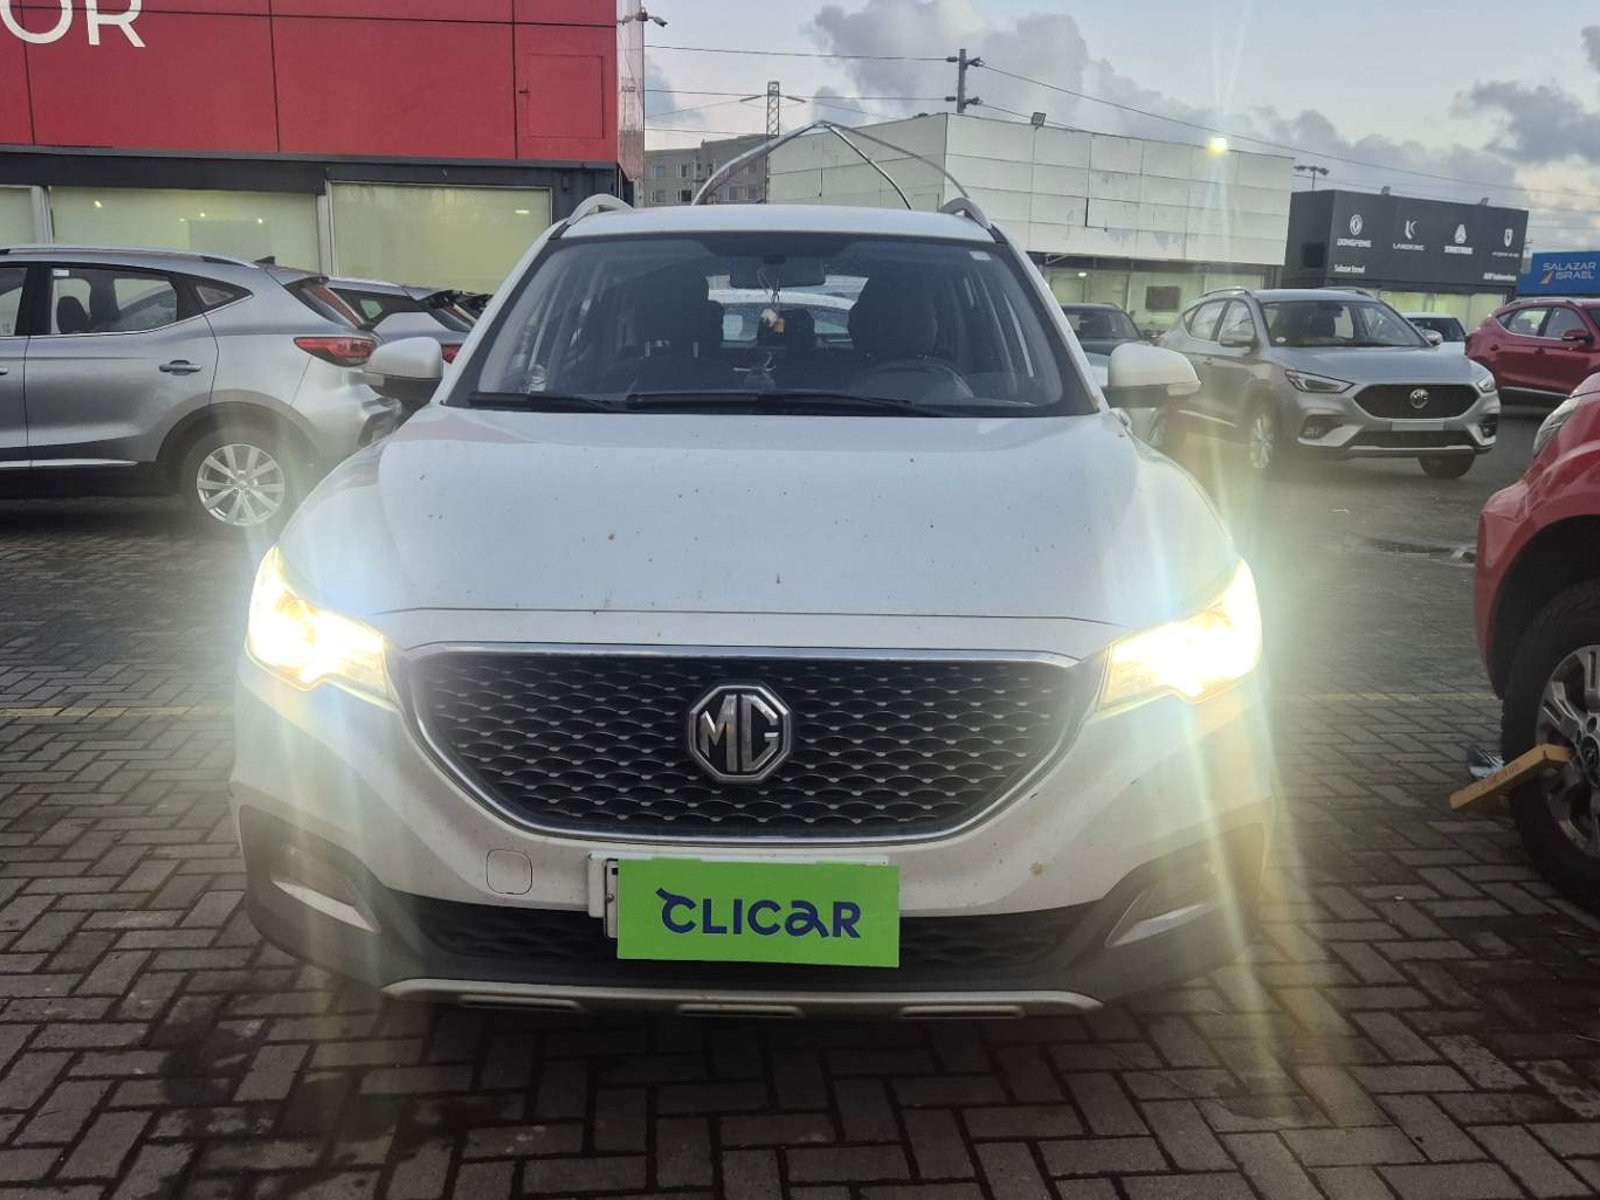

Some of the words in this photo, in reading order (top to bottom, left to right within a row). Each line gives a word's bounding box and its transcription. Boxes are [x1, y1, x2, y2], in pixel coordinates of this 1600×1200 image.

[1542, 261, 1597, 271] SALAZAR
[1555, 270, 1595, 280] ISRAEL
[699, 692, 781, 773] MG
